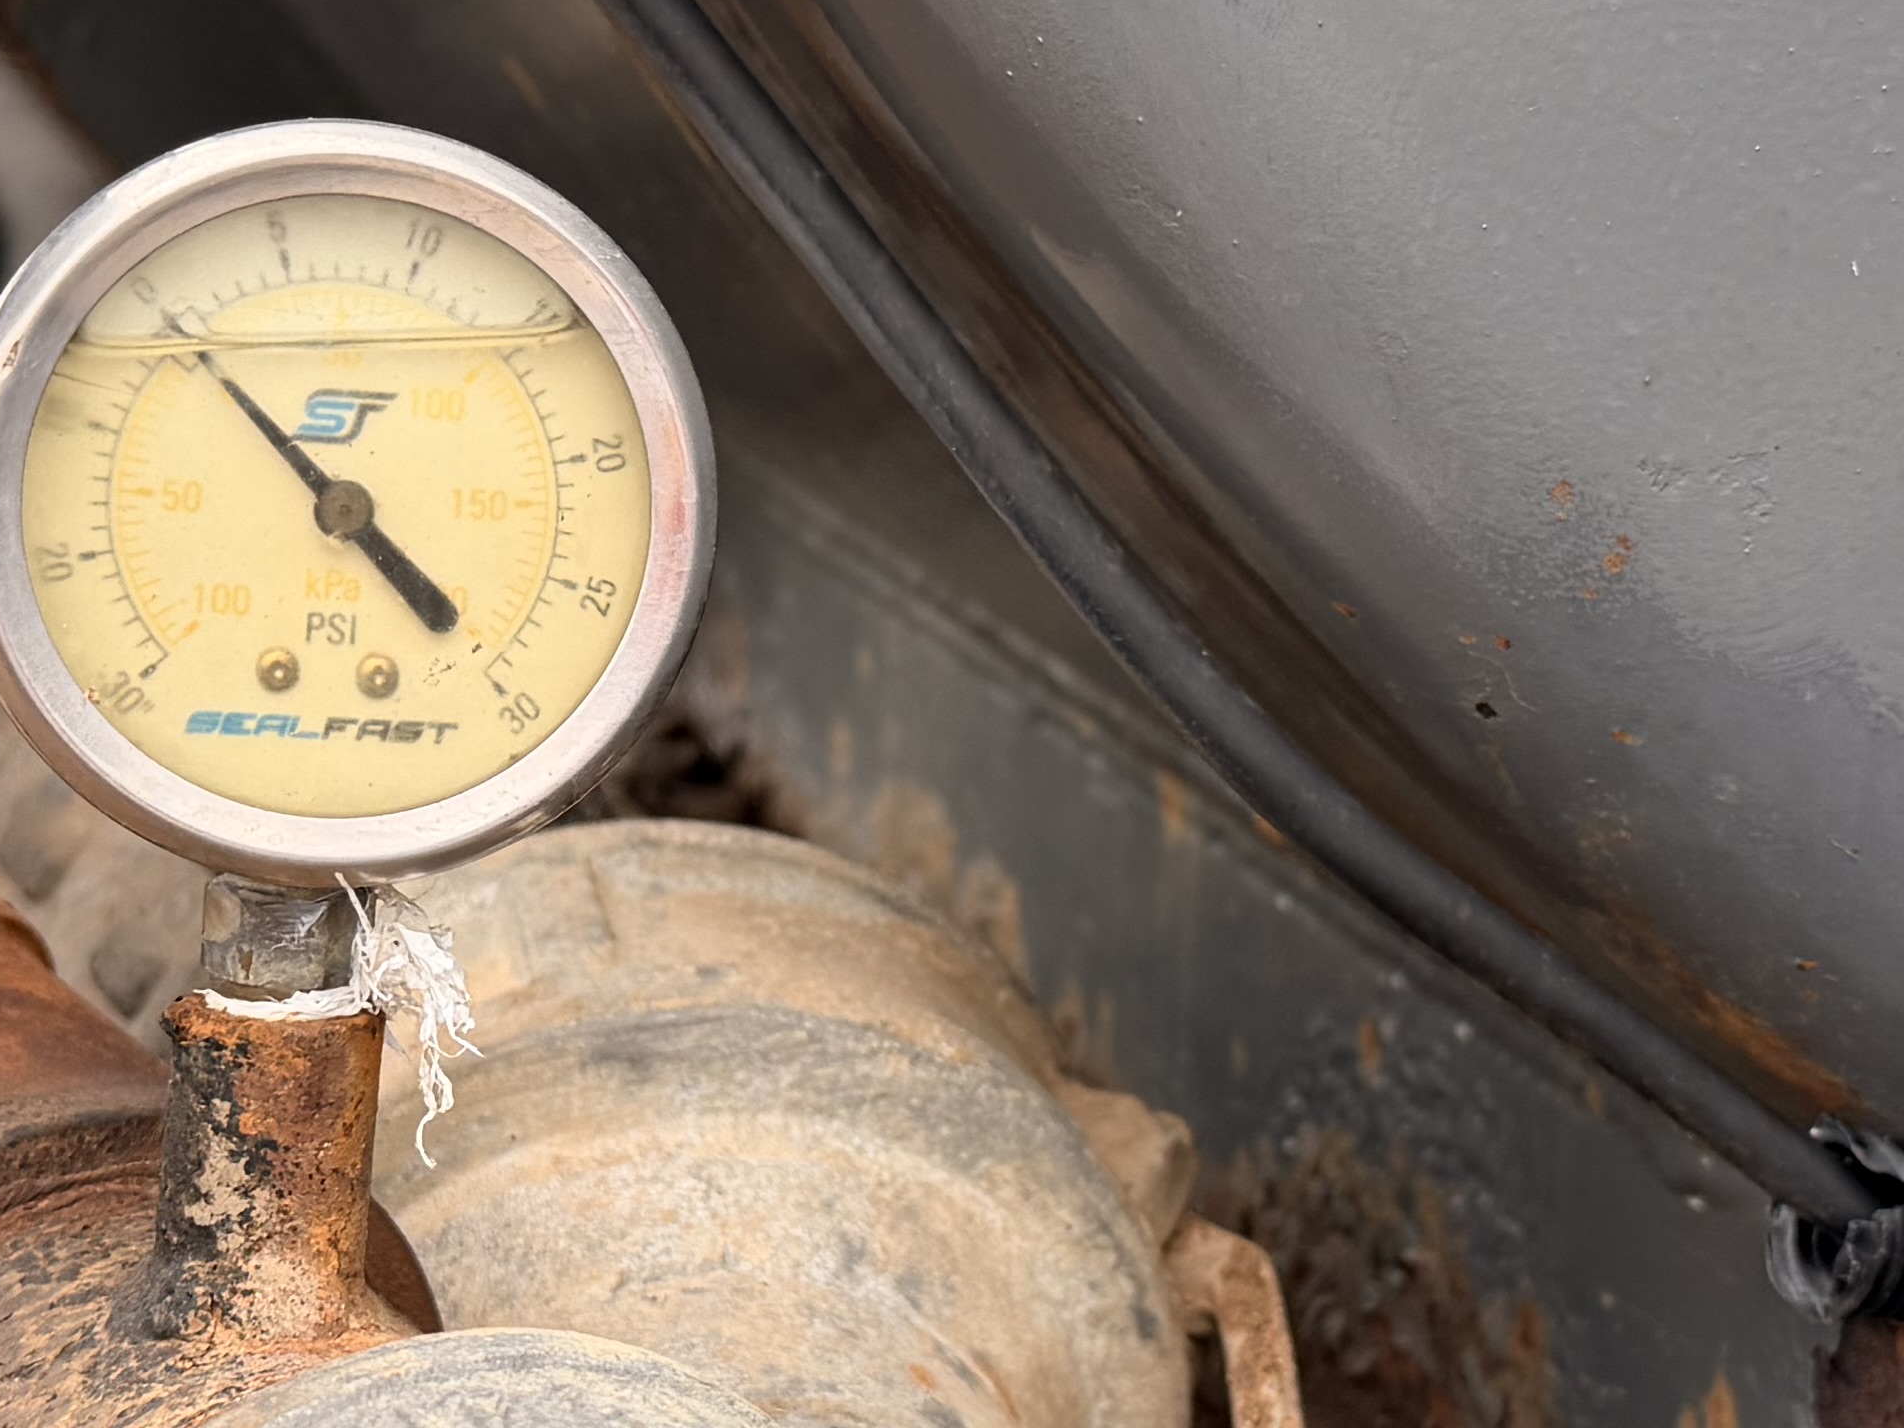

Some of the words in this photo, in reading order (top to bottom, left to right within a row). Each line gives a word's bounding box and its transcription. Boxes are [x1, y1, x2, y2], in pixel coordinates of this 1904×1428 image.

[406, 222, 444, 258] 10
[409, 389, 468, 422] 100
[592, 434, 627, 473] 20
[162, 478, 204, 513] 50
[452, 489, 508, 520] 150
[35, 541, 75, 584] 20
[193, 582, 253, 616] 100
[305, 568, 362, 603] kPa
[579, 575, 618, 618] 25
[305, 612, 357, 646] PSI
[184, 709, 459, 745] SEALFAST
[499, 692, 541, 735] 30
